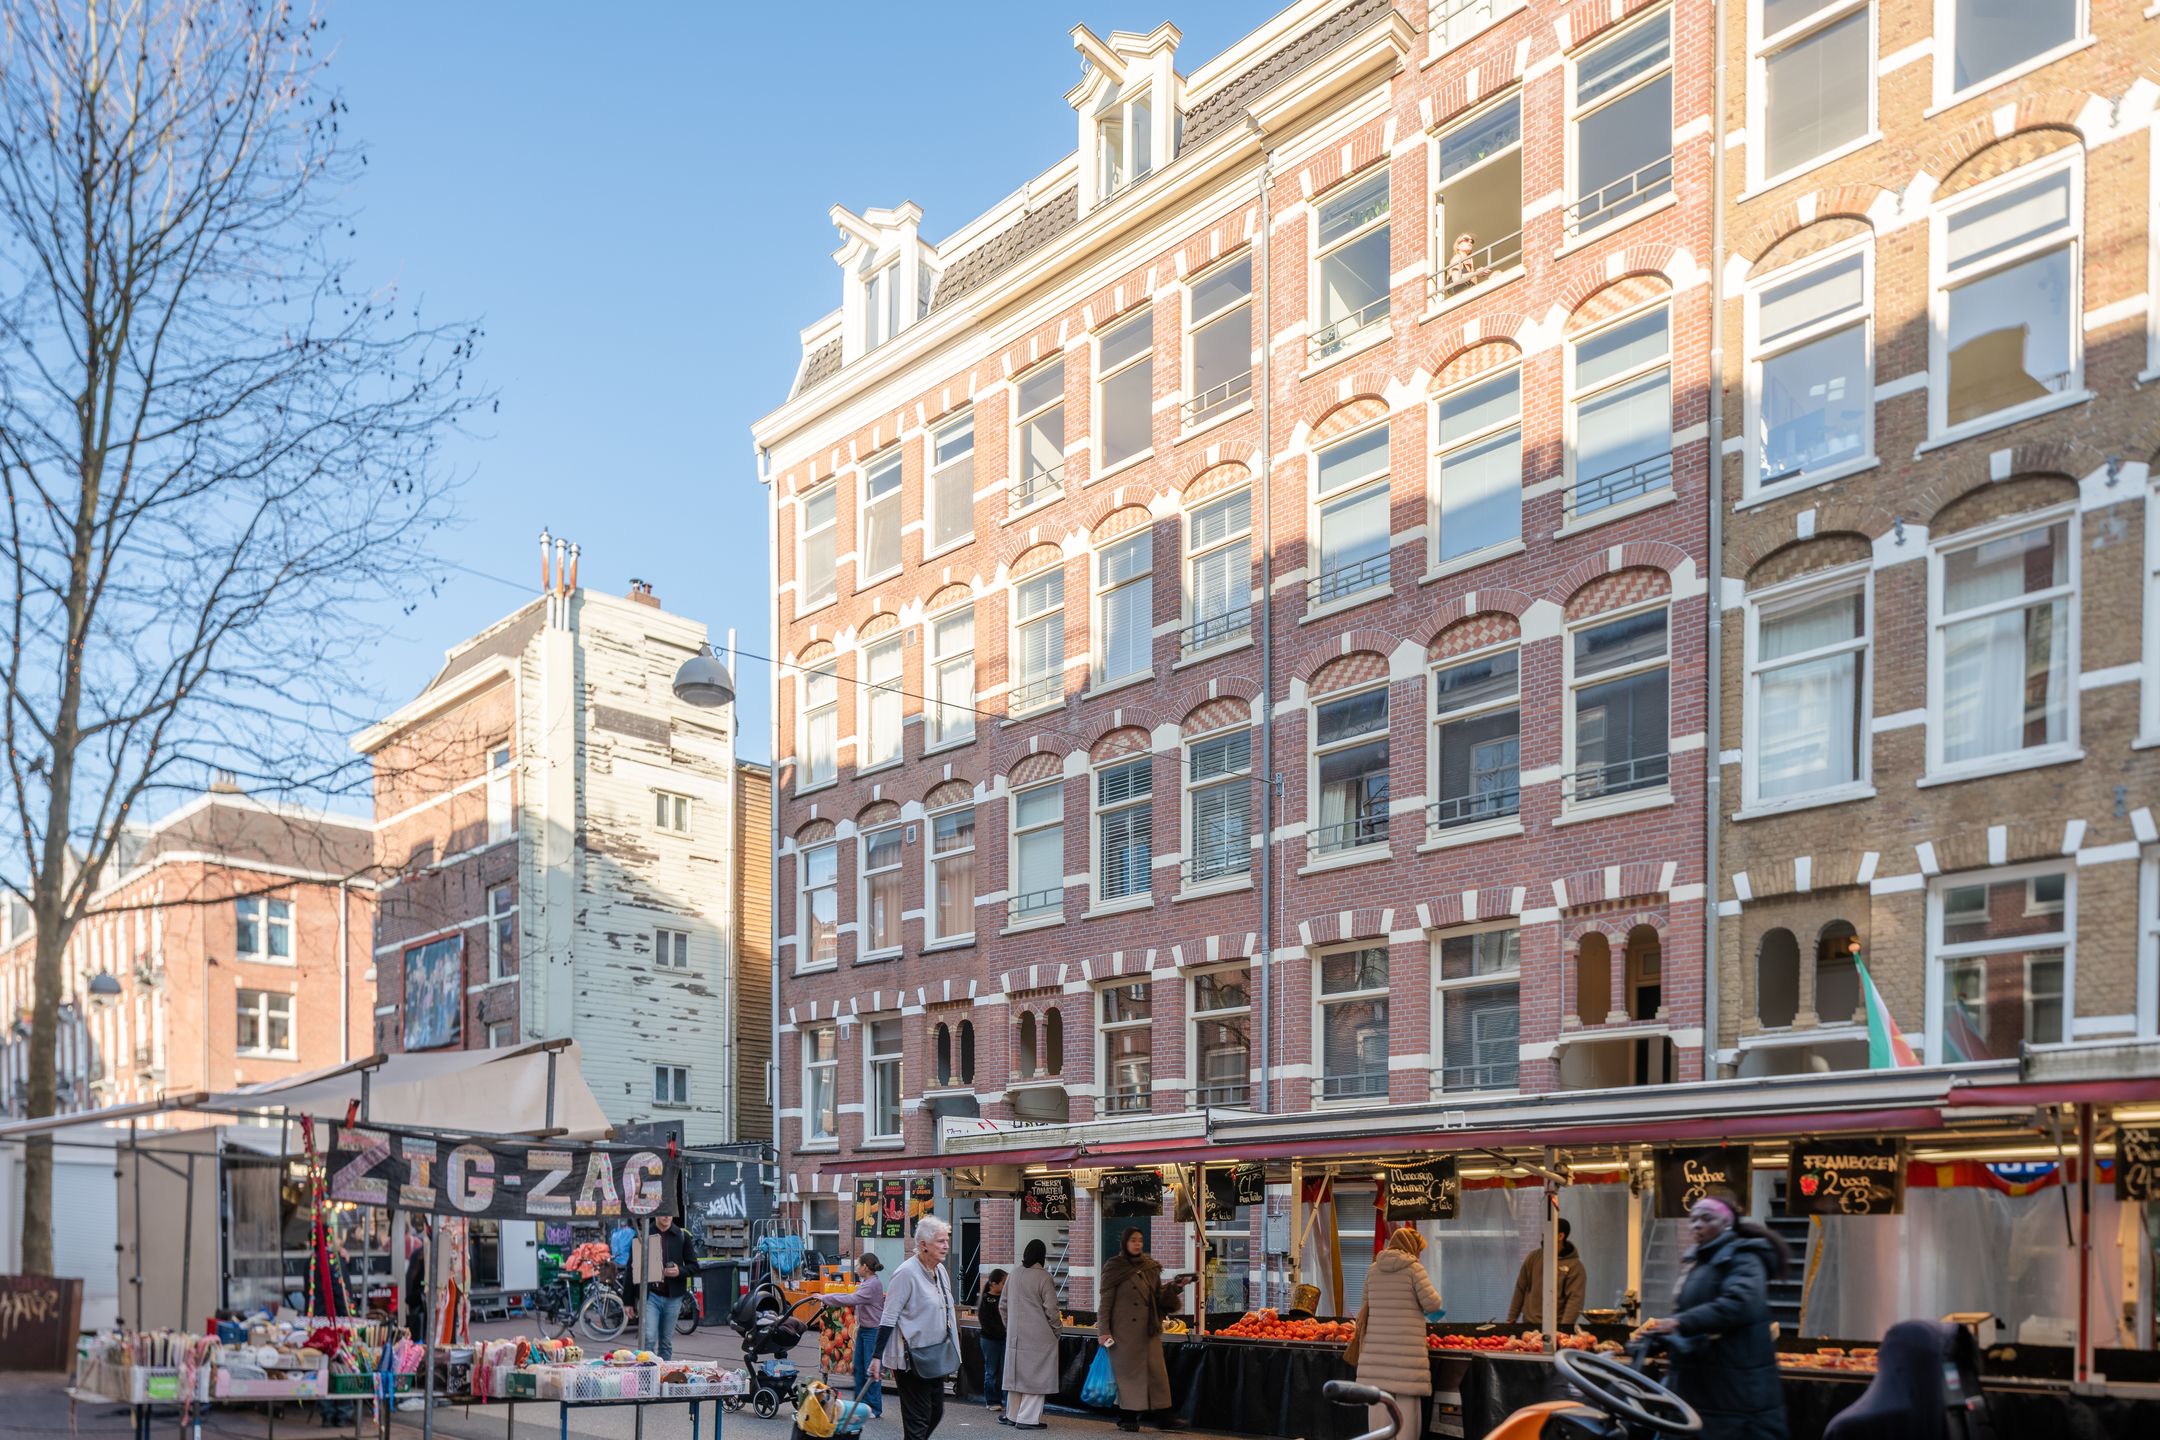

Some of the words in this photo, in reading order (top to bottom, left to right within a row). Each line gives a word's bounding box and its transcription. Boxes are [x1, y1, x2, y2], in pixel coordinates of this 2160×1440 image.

[330, 1126, 664, 1216] ZIG-ZAG
[1803, 1154, 1899, 1172] FRAMBOZEN
[1032, 1186, 1063, 1195] TOMATEN
[1034, 1179, 1062, 1187] CHERRY
[1823, 1170, 1840, 1195] 2
[706, 1183, 747, 1218] AGAIN
[1839, 1187, 1871, 1214] €3
